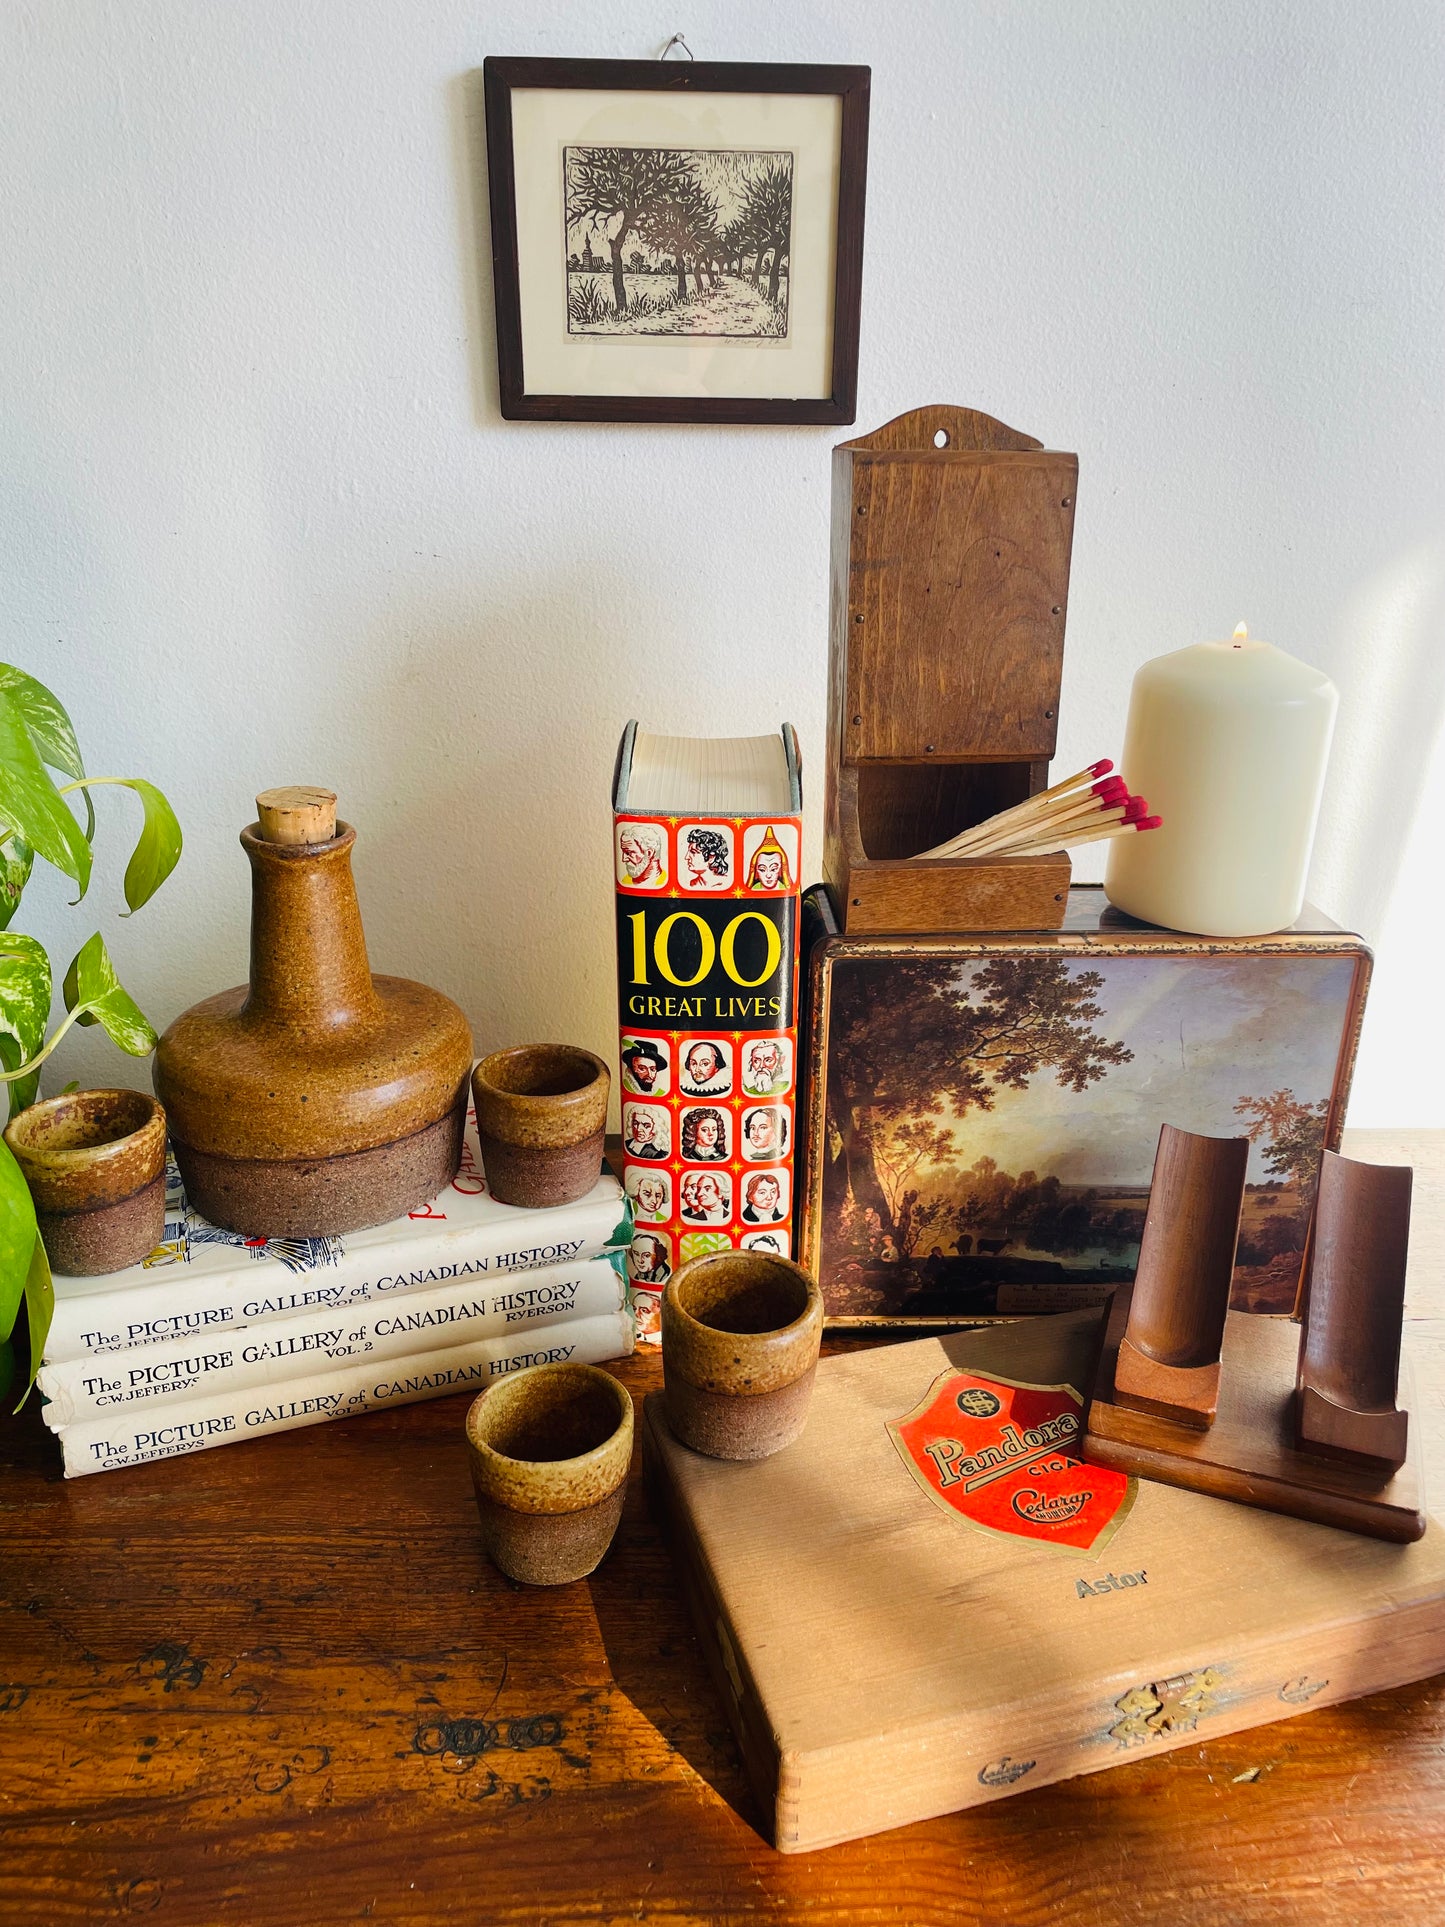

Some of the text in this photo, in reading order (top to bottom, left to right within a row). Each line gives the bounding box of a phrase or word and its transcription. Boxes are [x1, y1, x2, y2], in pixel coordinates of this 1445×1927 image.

[626, 910, 782, 988] 100
[629, 995, 782, 1018] GREAT LIVES
[507, 1254, 578, 1273] RYERSON
[80, 1239, 586, 1348] The PICTURE GALLERY of CANADIAN HISTORY
[505, 1299, 576, 1323] RYERSON
[82, 1280, 582, 1396] The PICTURE GALLERY of CANADIAN HISTORY
[364, 1341, 374, 1351] 2
[90, 1344, 577, 1461] The PICTURE GALLERY of CANADIAN HISTORY
[923, 1412, 1080, 1488] Pandora
[1028, 1458, 1080, 1477] CIGA
[1074, 1570, 1148, 1600] Astor
